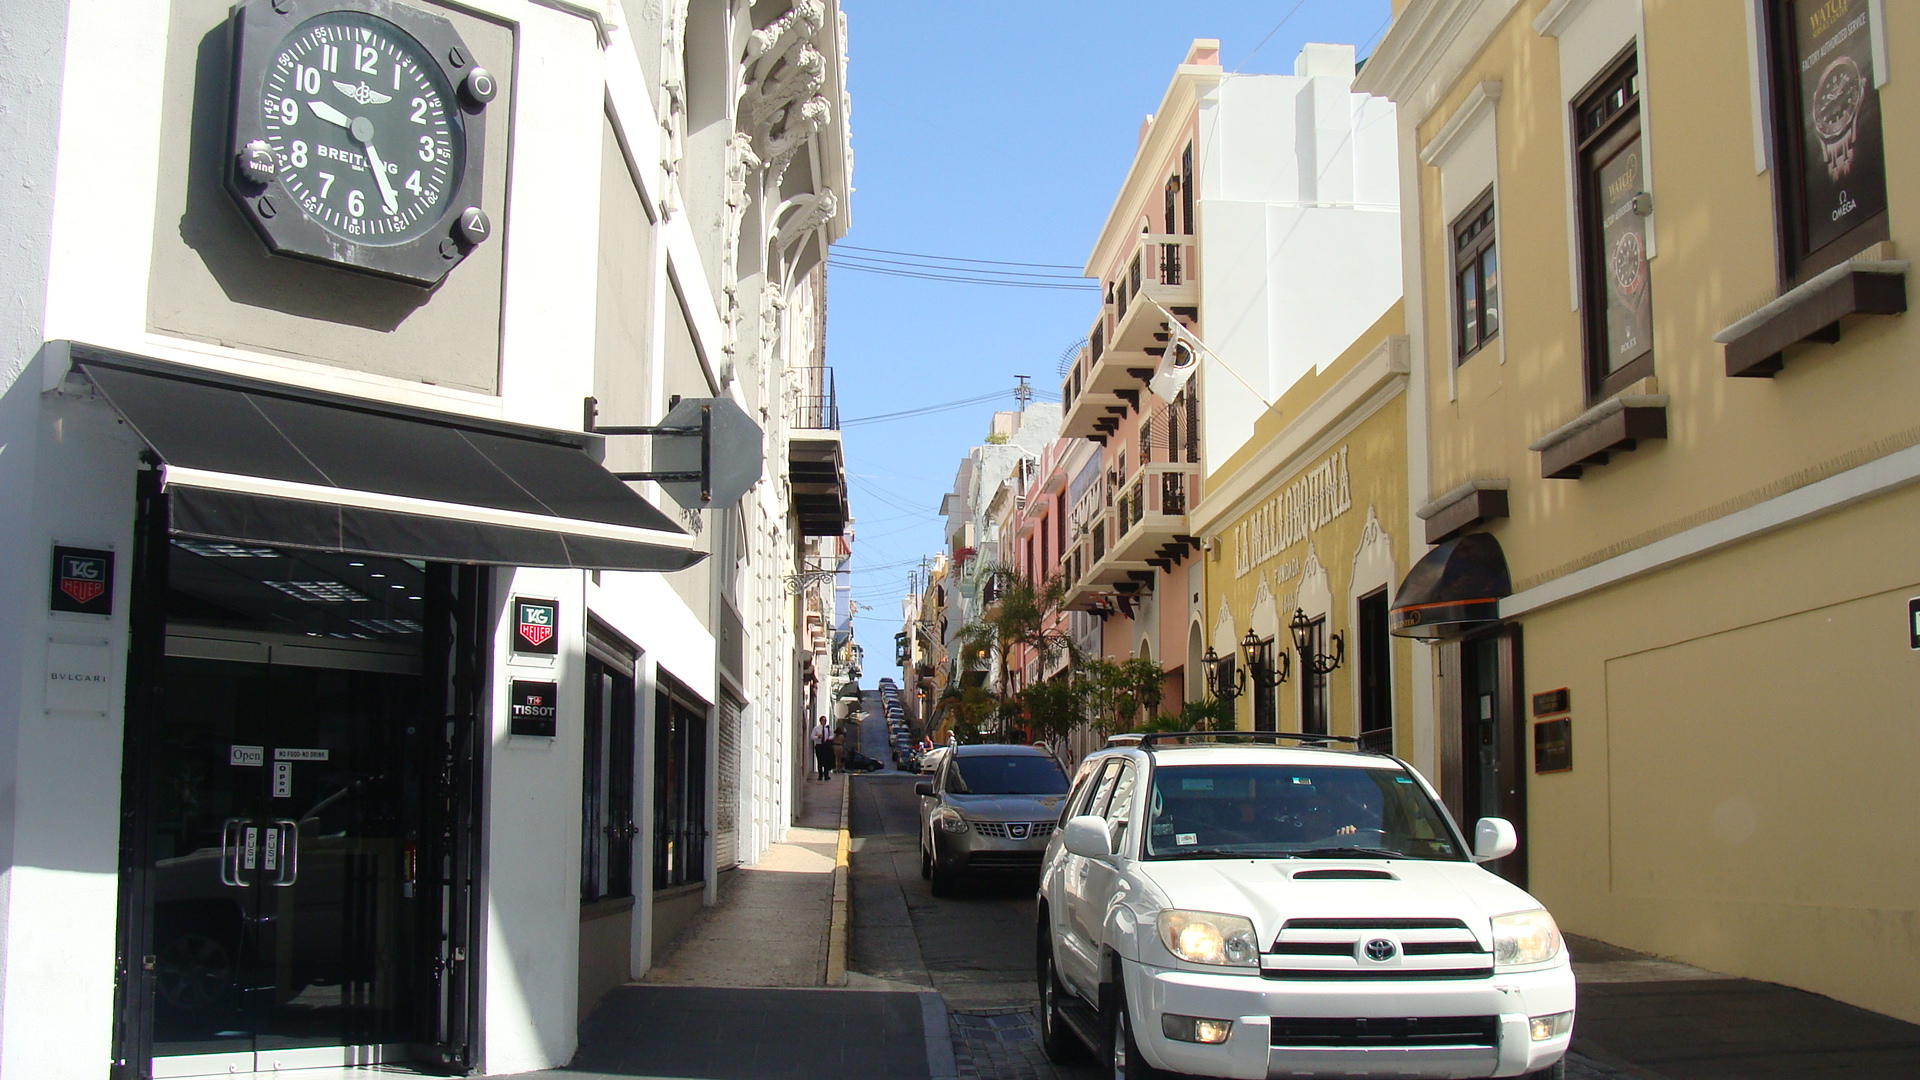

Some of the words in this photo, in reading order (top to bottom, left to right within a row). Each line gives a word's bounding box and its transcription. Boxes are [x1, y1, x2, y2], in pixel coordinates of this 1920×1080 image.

[314, 27, 327, 38] 55
[1802, 50, 1820, 72] FACTORY
[1820, 28, 1848, 58] AUTHORIZED
[1847, 12, 1866, 36] SERVICE
[278, 52, 291, 67] 50
[322, 44, 338, 74] 11
[355, 43, 378, 76] 12
[296, 63, 321, 95] 10
[394, 64, 401, 91] 1
[264, 99, 274, 115] 45
[281, 98, 299, 126] 9
[411, 97, 428, 125] 2
[432, 97, 443, 108] 10
[291, 140, 309, 168] 8
[418, 135, 435, 162] 3
[442, 147, 451, 159] 15
[250, 159, 275, 174] wind
[317, 144, 399, 175] BREITLNG
[319, 171, 335, 199] 7
[405, 169, 422, 197] 4
[1608, 169, 1632, 198] WATCH
[303, 199, 317, 213] 35
[348, 189, 365, 217] 6
[427, 191, 439, 205] 20
[1831, 198, 1857, 221] OMEGA
[348, 223, 361, 236] 30
[394, 220, 407, 233] 25
[1620, 336, 1638, 354] ROLEX
[1235, 518, 1251, 580] LA
[1250, 443, 1353, 570] MALLORQUINA
[70, 560, 99, 579] TAG
[65, 581, 102, 600] HEUER
[526, 608, 549, 624] TAG
[523, 626, 550, 643] HEUER
[51, 672, 106, 683] BVLGARI
[513, 704, 555, 716] TISSOT
[233, 749, 261, 761] Open
[247, 833, 255, 864] PUSH
[267, 834, 276, 865] PUSH
